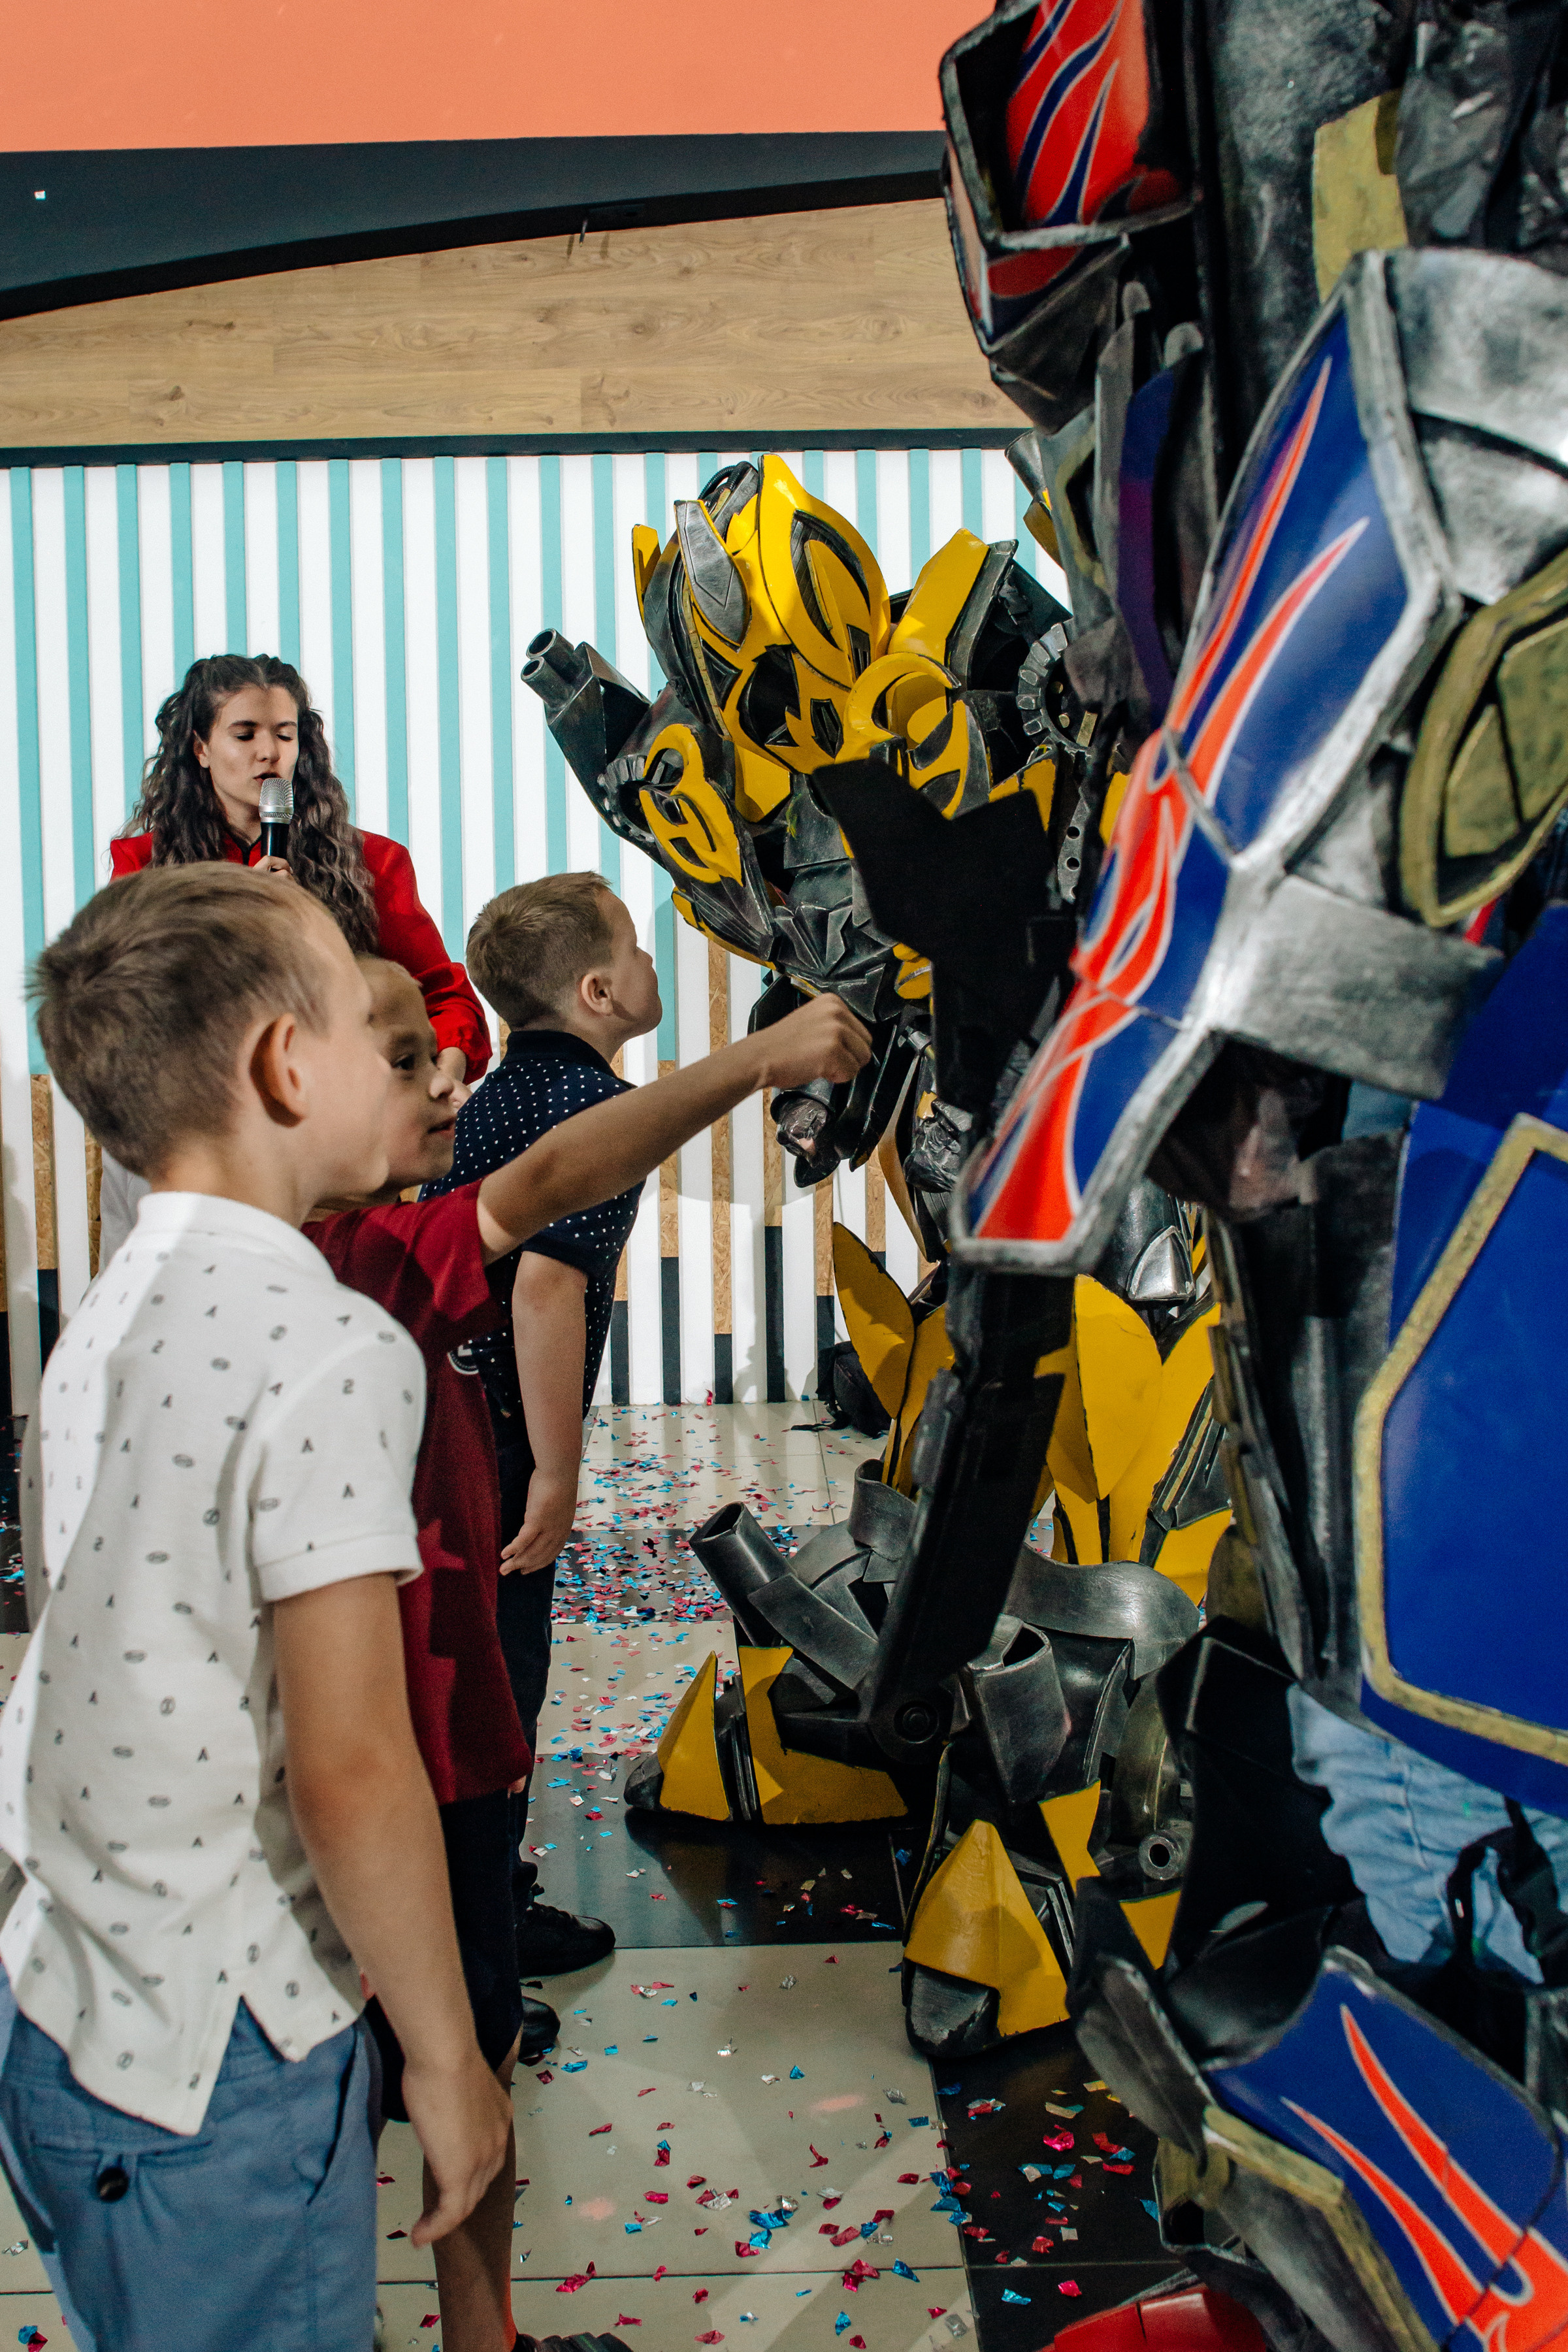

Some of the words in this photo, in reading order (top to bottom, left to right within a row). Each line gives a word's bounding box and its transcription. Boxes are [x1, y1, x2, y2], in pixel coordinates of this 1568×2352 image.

[341, 1378, 355, 1396] 2
[301, 1438, 314, 1454] A
[342, 1483, 355, 1499] A
[207, 1650, 220, 1663] A
[197, 1747, 209, 1762] A
[233, 1792, 244, 1805] A
[191, 1836, 203, 1848] A
[216, 1969, 229, 1984] A
